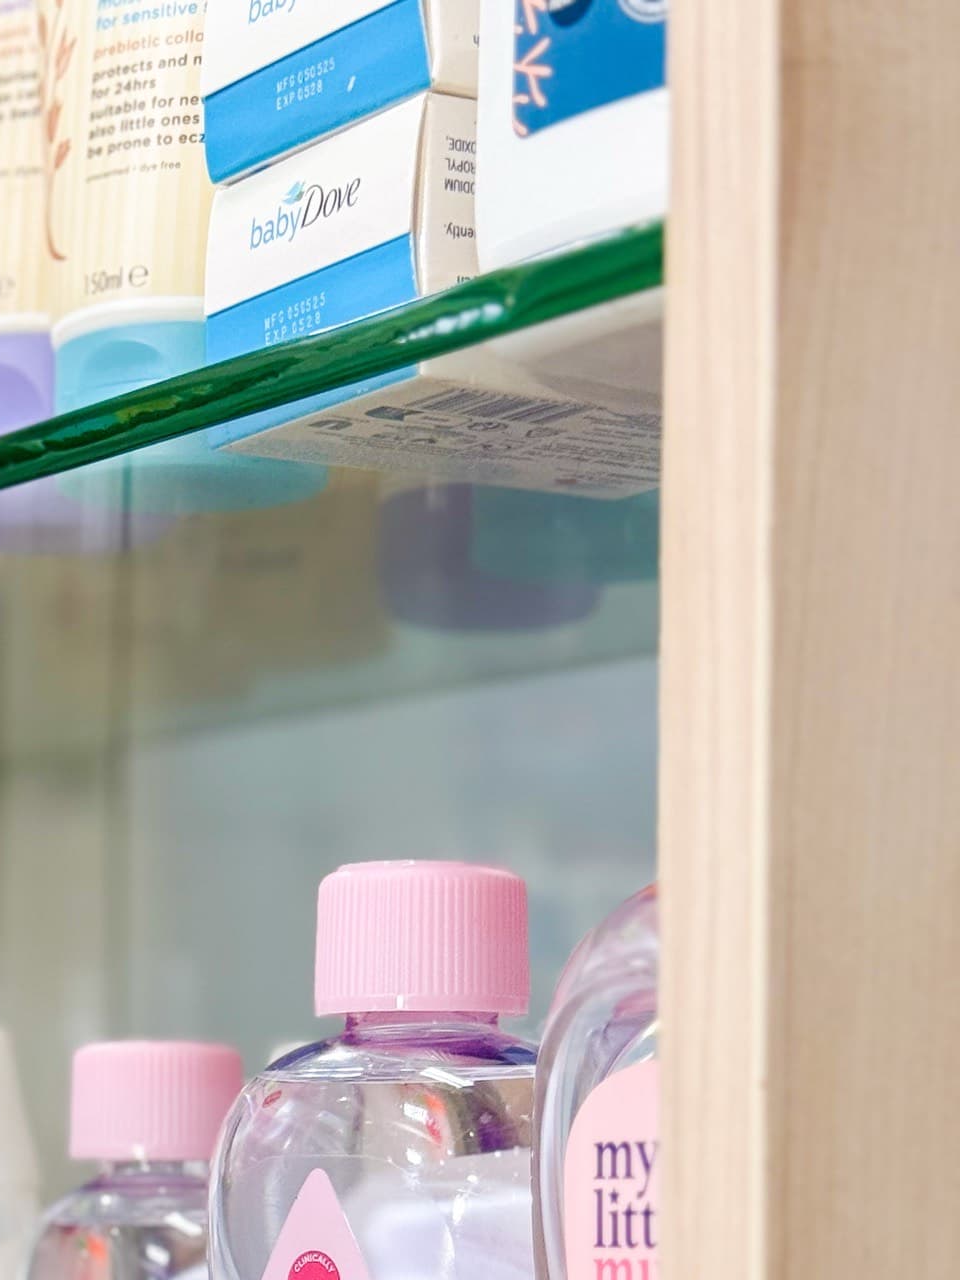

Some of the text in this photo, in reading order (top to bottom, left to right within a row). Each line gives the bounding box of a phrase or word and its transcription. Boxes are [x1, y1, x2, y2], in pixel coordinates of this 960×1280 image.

[122, 2, 198, 25] sensitive
[93, 36, 160, 62] prebiotic
[92, 59, 153, 84] protects
[158, 53, 188, 70] and
[91, 77, 156, 100] for 24hrs
[90, 99, 146, 123] suitable
[151, 95, 174, 110] for
[276, 91, 296, 111] EXP
[120, 115, 155, 133] little
[161, 114, 200, 127] ones
[107, 137, 152, 155] prone
[157, 133, 173, 146] to
[443, 222, 476, 239] ently.
[83, 265, 124, 296] 150ml
[263, 309, 285, 331] MFG
[264, 325, 288, 346] EXP
[293, 1252, 337, 1274] CLINICALLY
